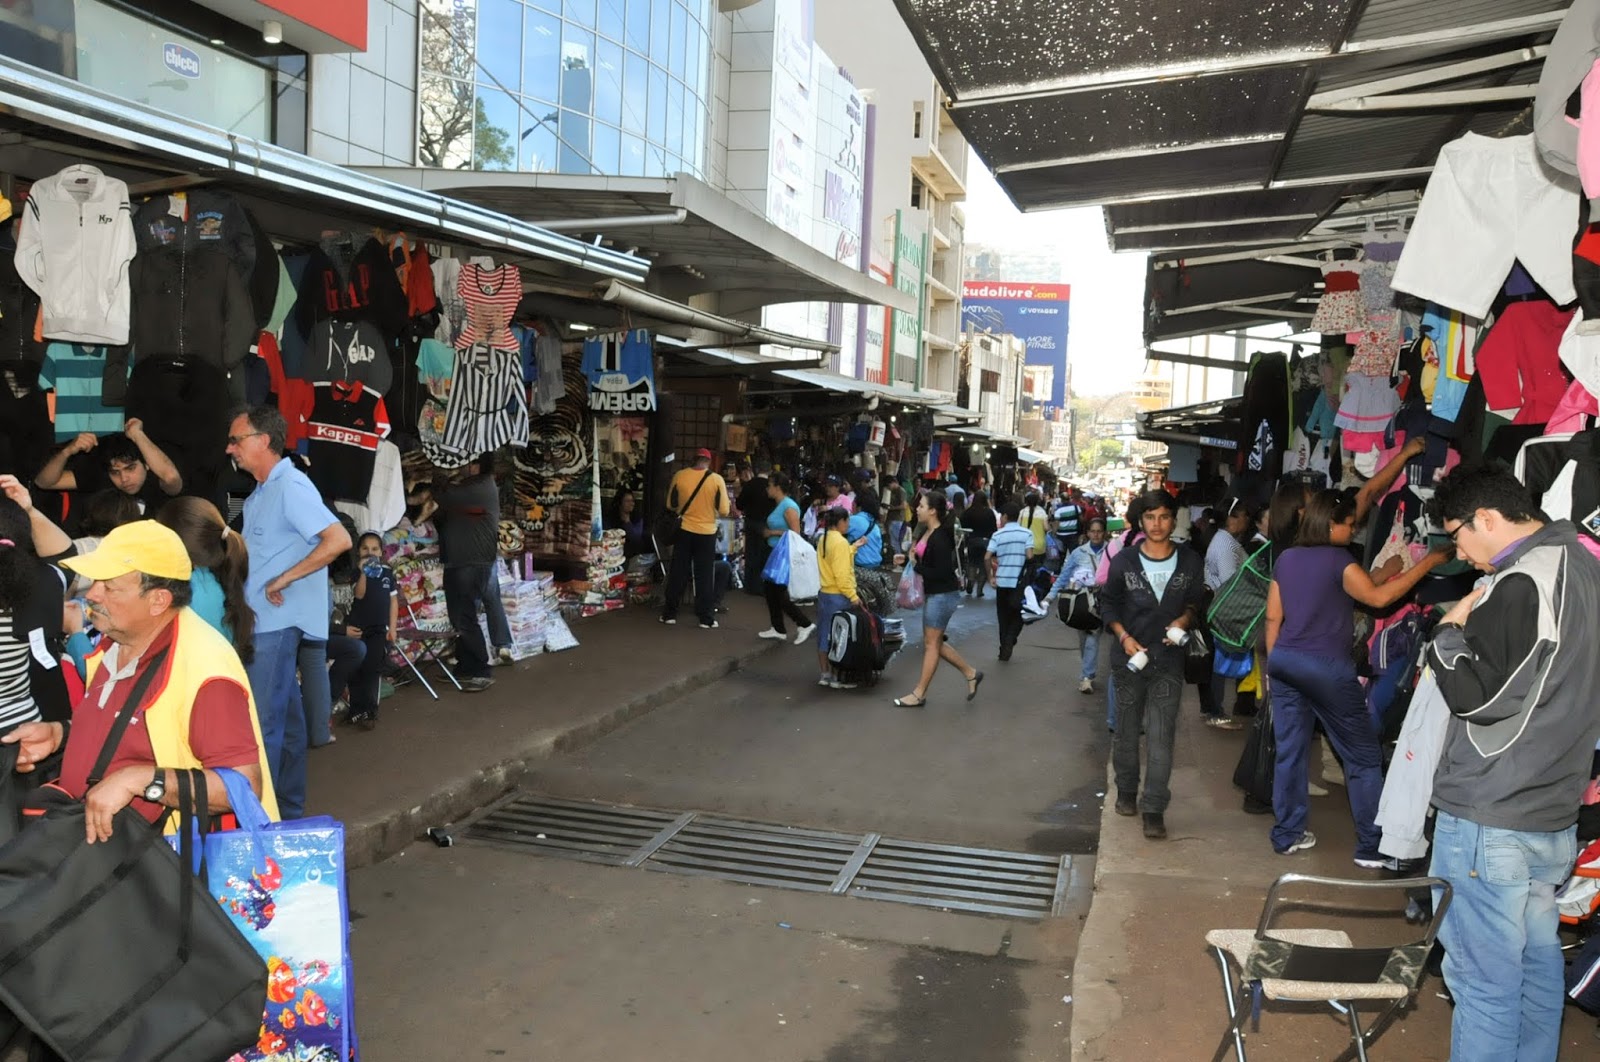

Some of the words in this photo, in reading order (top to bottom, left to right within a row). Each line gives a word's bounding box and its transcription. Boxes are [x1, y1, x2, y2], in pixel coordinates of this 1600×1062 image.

[165, 48, 198, 74] chicco
[324, 263, 370, 312] GAP
[1027, 307, 1059, 315] VOYAGER
[1026, 335, 1053, 343] MORE
[1026, 341, 1056, 350] FITNESS
[348, 344, 376, 364] GAP
[317, 426, 362, 442] Kappa
